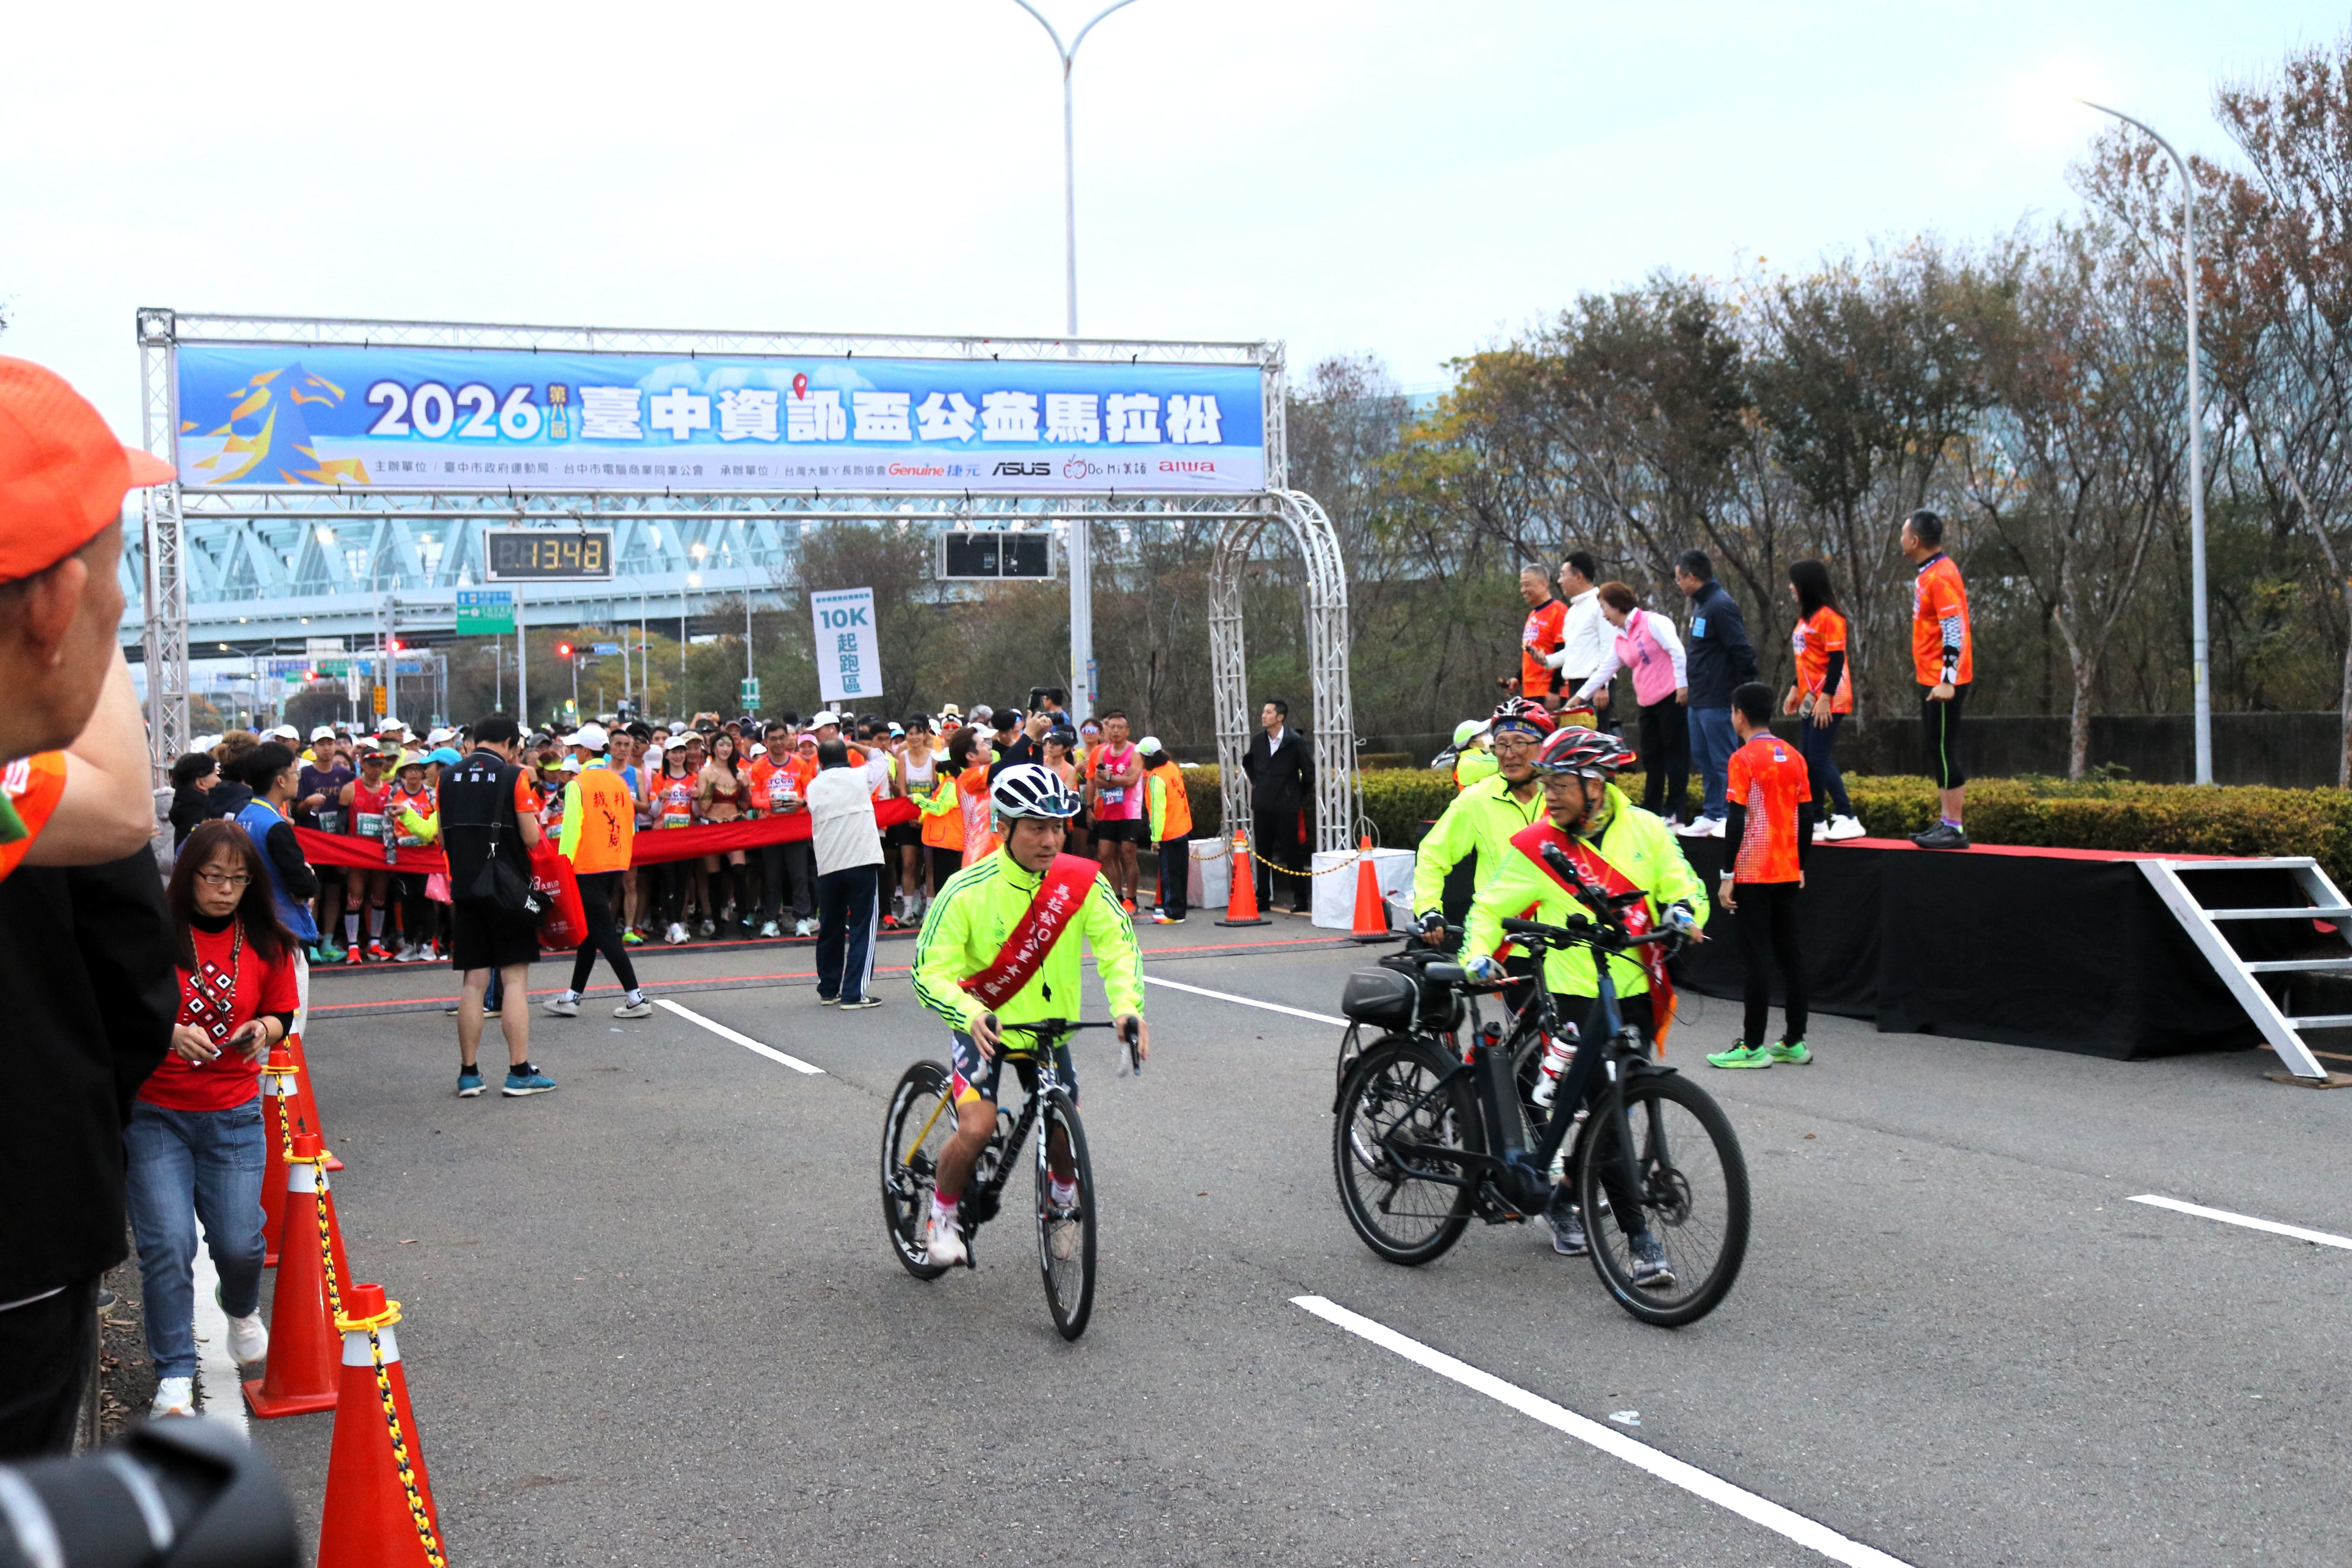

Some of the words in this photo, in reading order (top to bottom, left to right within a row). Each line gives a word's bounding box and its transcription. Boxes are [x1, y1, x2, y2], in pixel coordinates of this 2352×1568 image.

[368, 382, 541, 439] 2026
[579, 386, 1222, 444] 臺中資訊盃公益馬拉松
[375, 460, 426, 472] 主辦單位
[720, 465, 768, 476] 承辦單位
[889, 463, 944, 476] Genuine
[947, 464, 980, 477] 捷元
[992, 462, 1051, 476] ASUS
[1088, 463, 1103, 474] Do
[1107, 464, 1120, 475] Mi
[1159, 461, 1215, 472] aiwa
[820, 607, 869, 629] 10K
[837, 632, 862, 693] 起跑區
